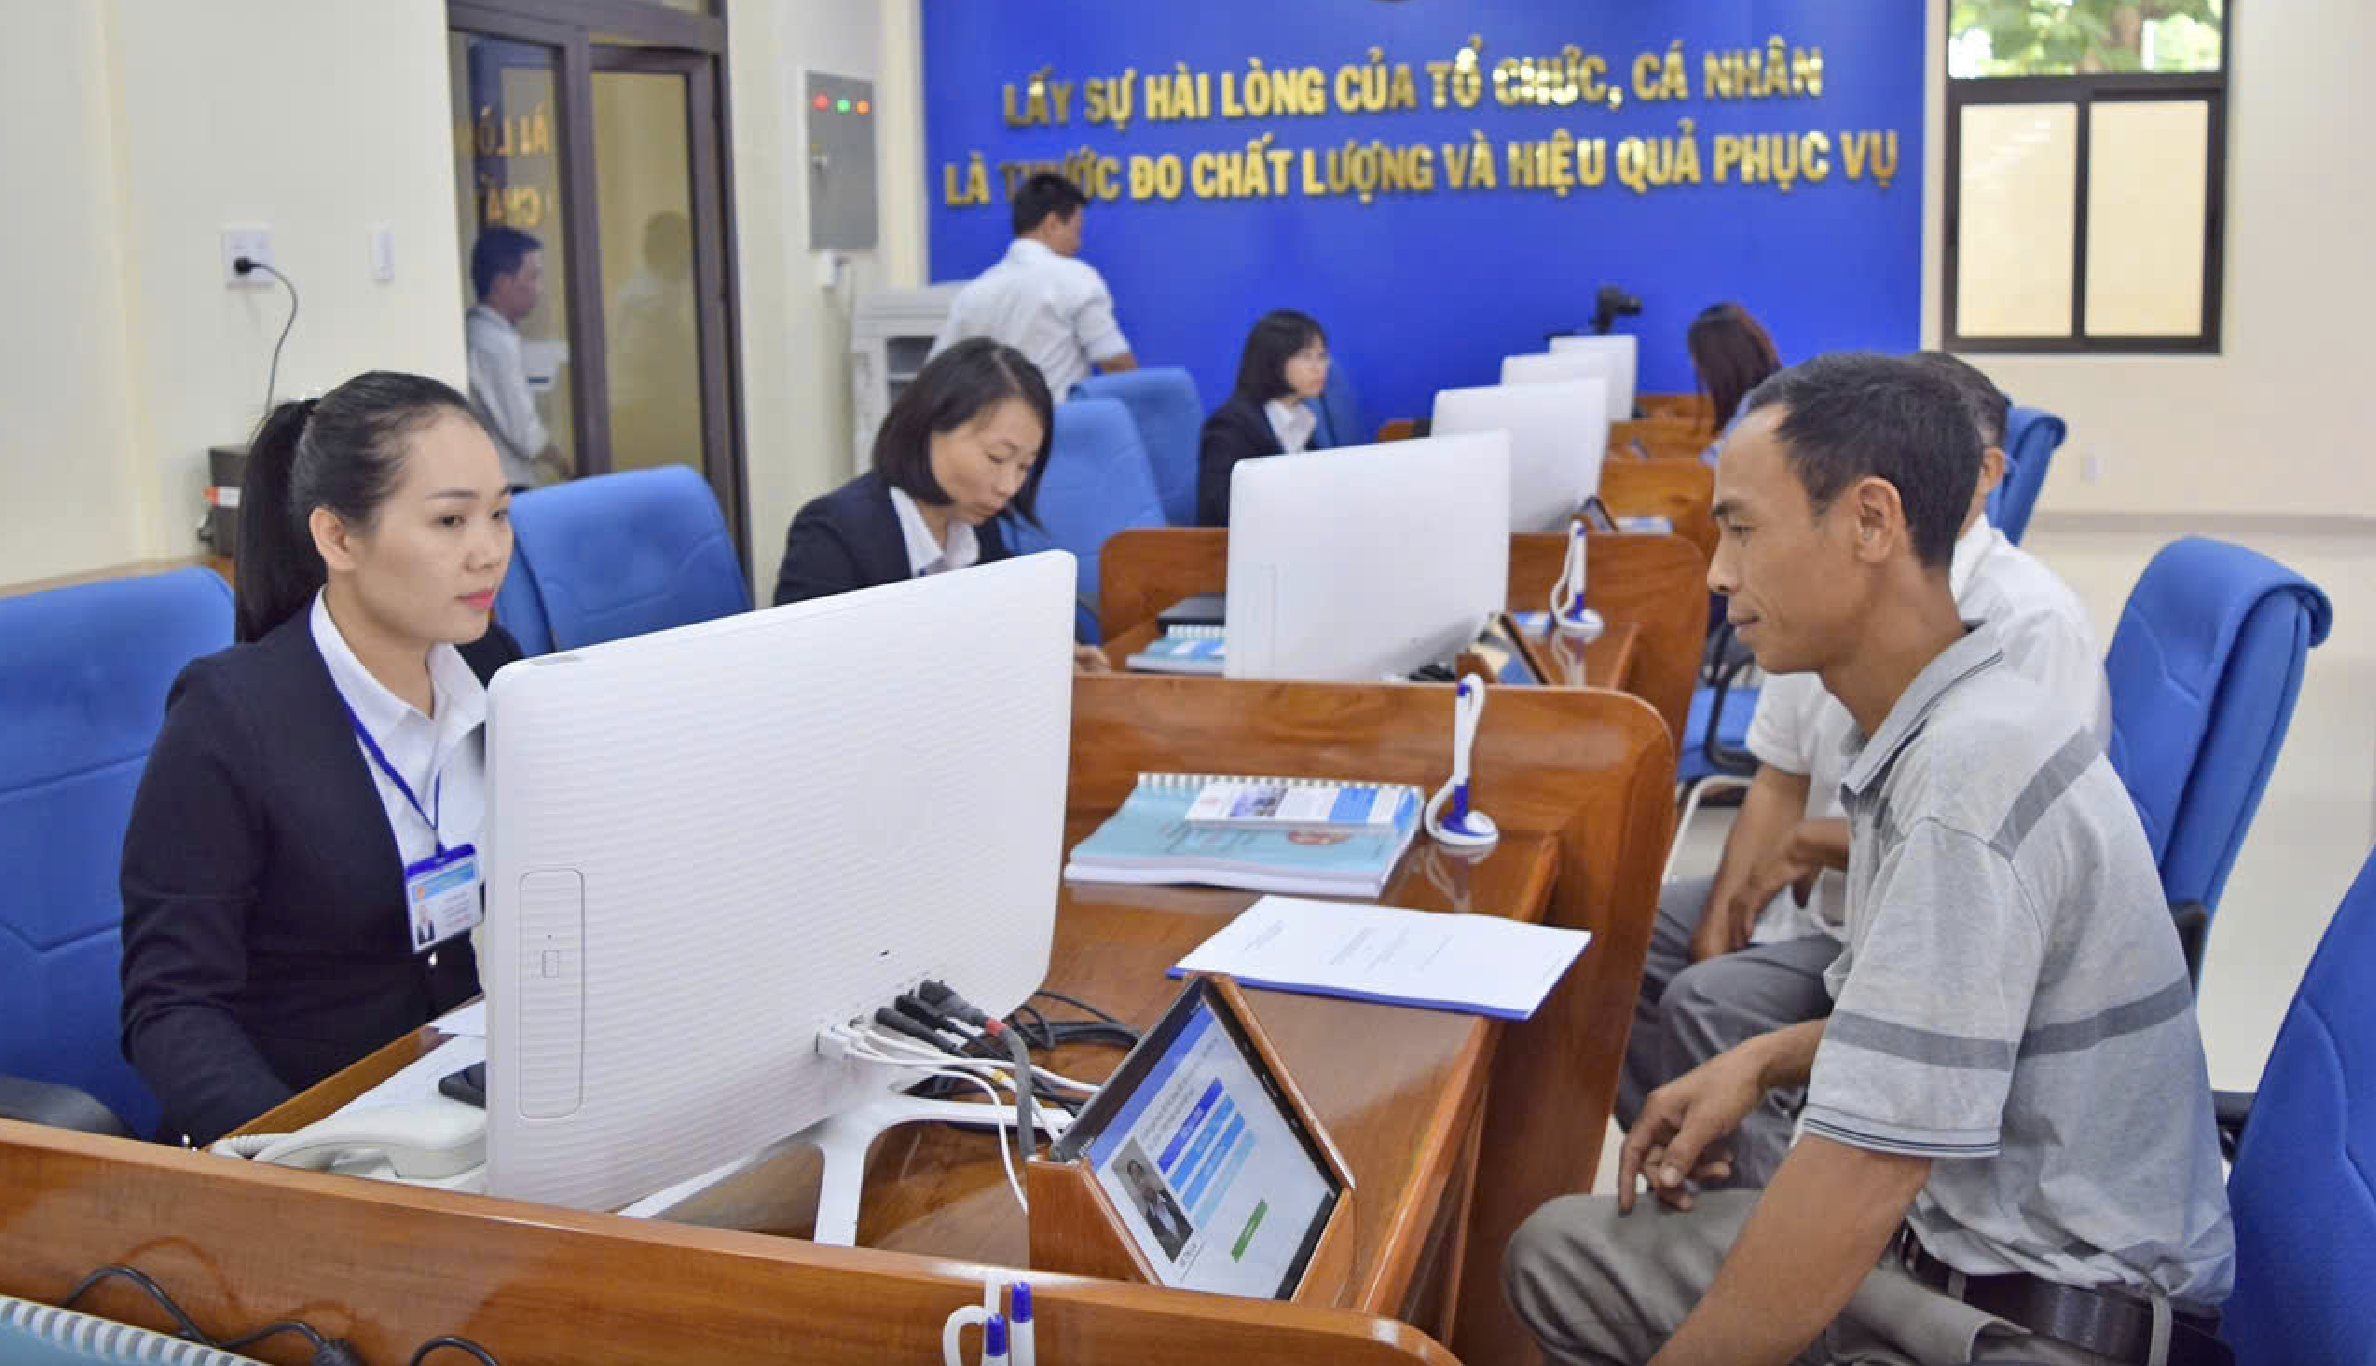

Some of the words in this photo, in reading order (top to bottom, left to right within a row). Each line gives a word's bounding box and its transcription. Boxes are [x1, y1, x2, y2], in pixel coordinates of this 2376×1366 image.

[1003, 65, 1074, 129] LẤY
[1083, 69, 1138, 135] SỰ
[1145, 61, 1211, 120] HÀI
[1220, 57, 1326, 117] LÒNG
[1335, 47, 1418, 113] CỦA
[1427, 34, 1483, 111] TỔ
[1632, 40, 1689, 101] CÁ
[1704, 36, 1824, 100] NHÂN
[944, 152, 992, 206] LÀ
[1130, 155, 1185, 200] ĐO
[1192, 131, 1294, 199] CHẤT
[1303, 139, 1435, 205] LƯỢNG
[1442, 129, 1498, 190] VÀ
[1508, 129, 1606, 197] HIỆU
[1616, 118, 1702, 195] QUẢ
[1713, 130, 1830, 192] PHỤC
[1840, 128, 1899, 190] VỤ
